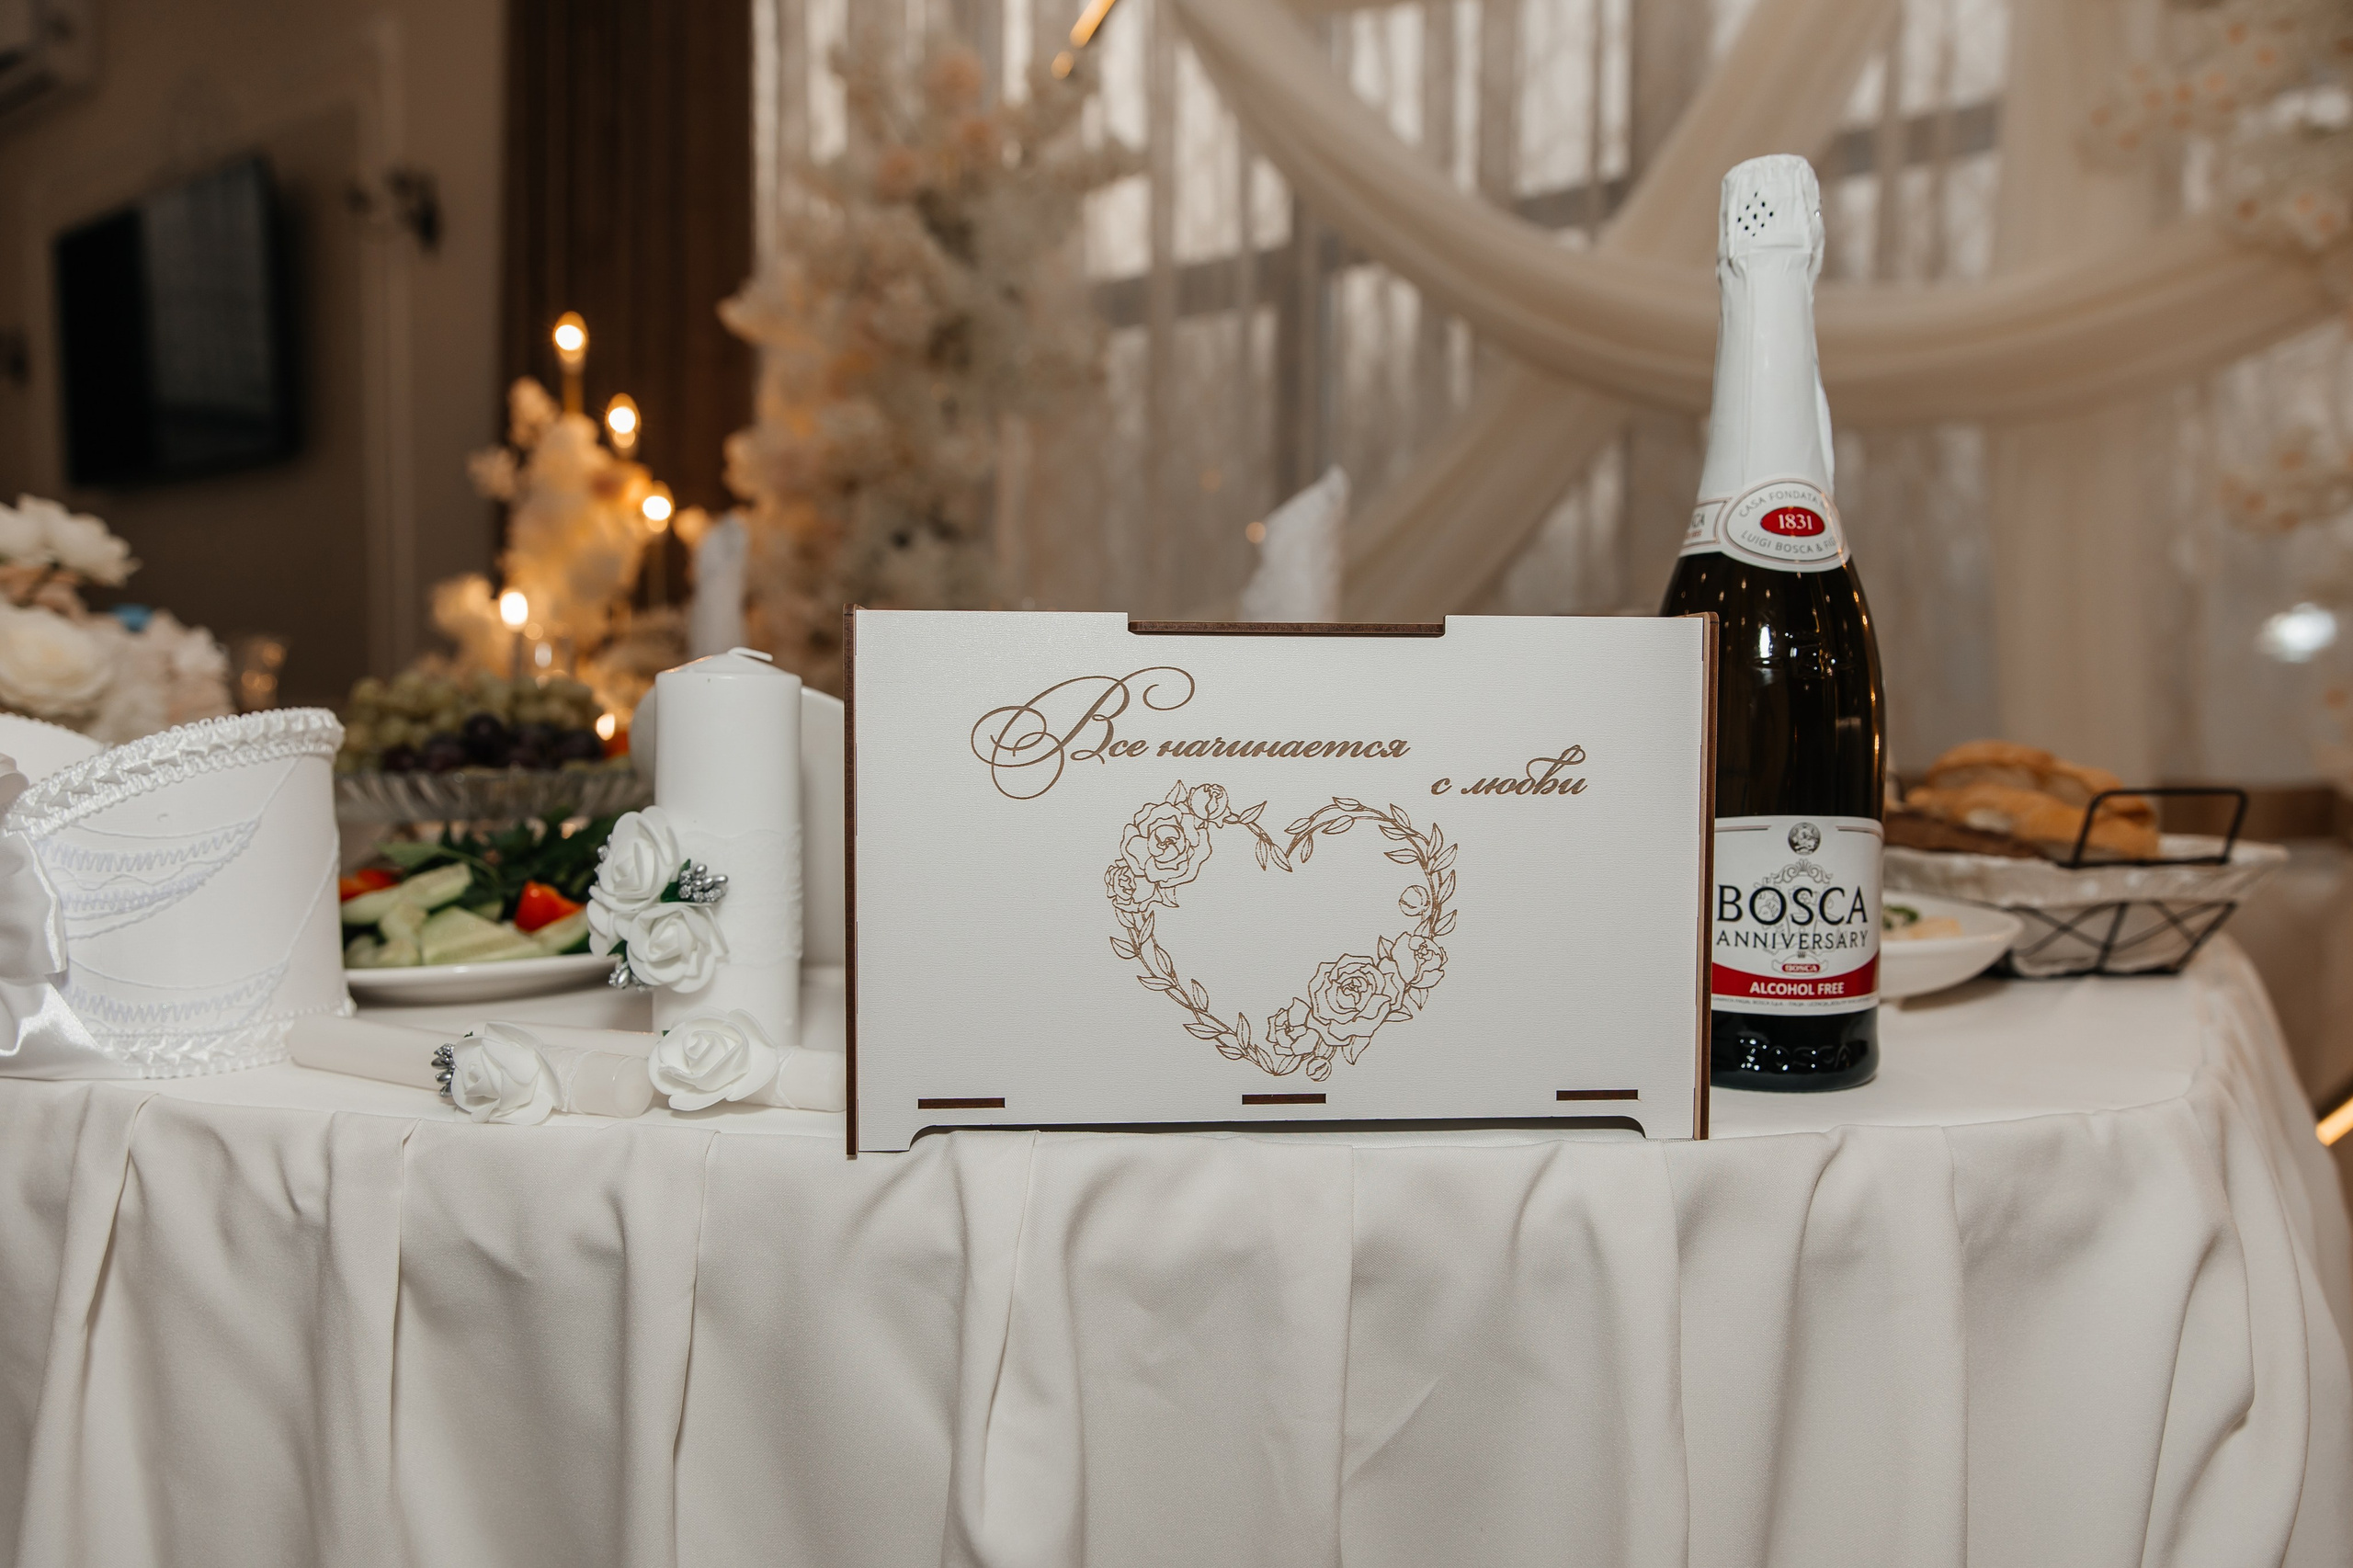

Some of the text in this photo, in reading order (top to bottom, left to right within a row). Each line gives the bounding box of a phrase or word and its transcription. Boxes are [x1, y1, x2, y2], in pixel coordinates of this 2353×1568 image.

[1739, 496, 1768, 517] CASA
[1769, 490, 1819, 506] FONDATA
[1778, 513, 1813, 530] 1831
[1741, 529, 1773, 549] LUIGI
[1775, 541, 1814, 554] BOSCA
[971, 665, 1411, 800] Все начинается
[1430, 744, 1588, 796] с любви
[1716, 884, 1870, 926] BOSCA
[1715, 929, 1870, 950] ANNIVERSARY
[1748, 981, 1846, 996] ALCOHOL FREE
